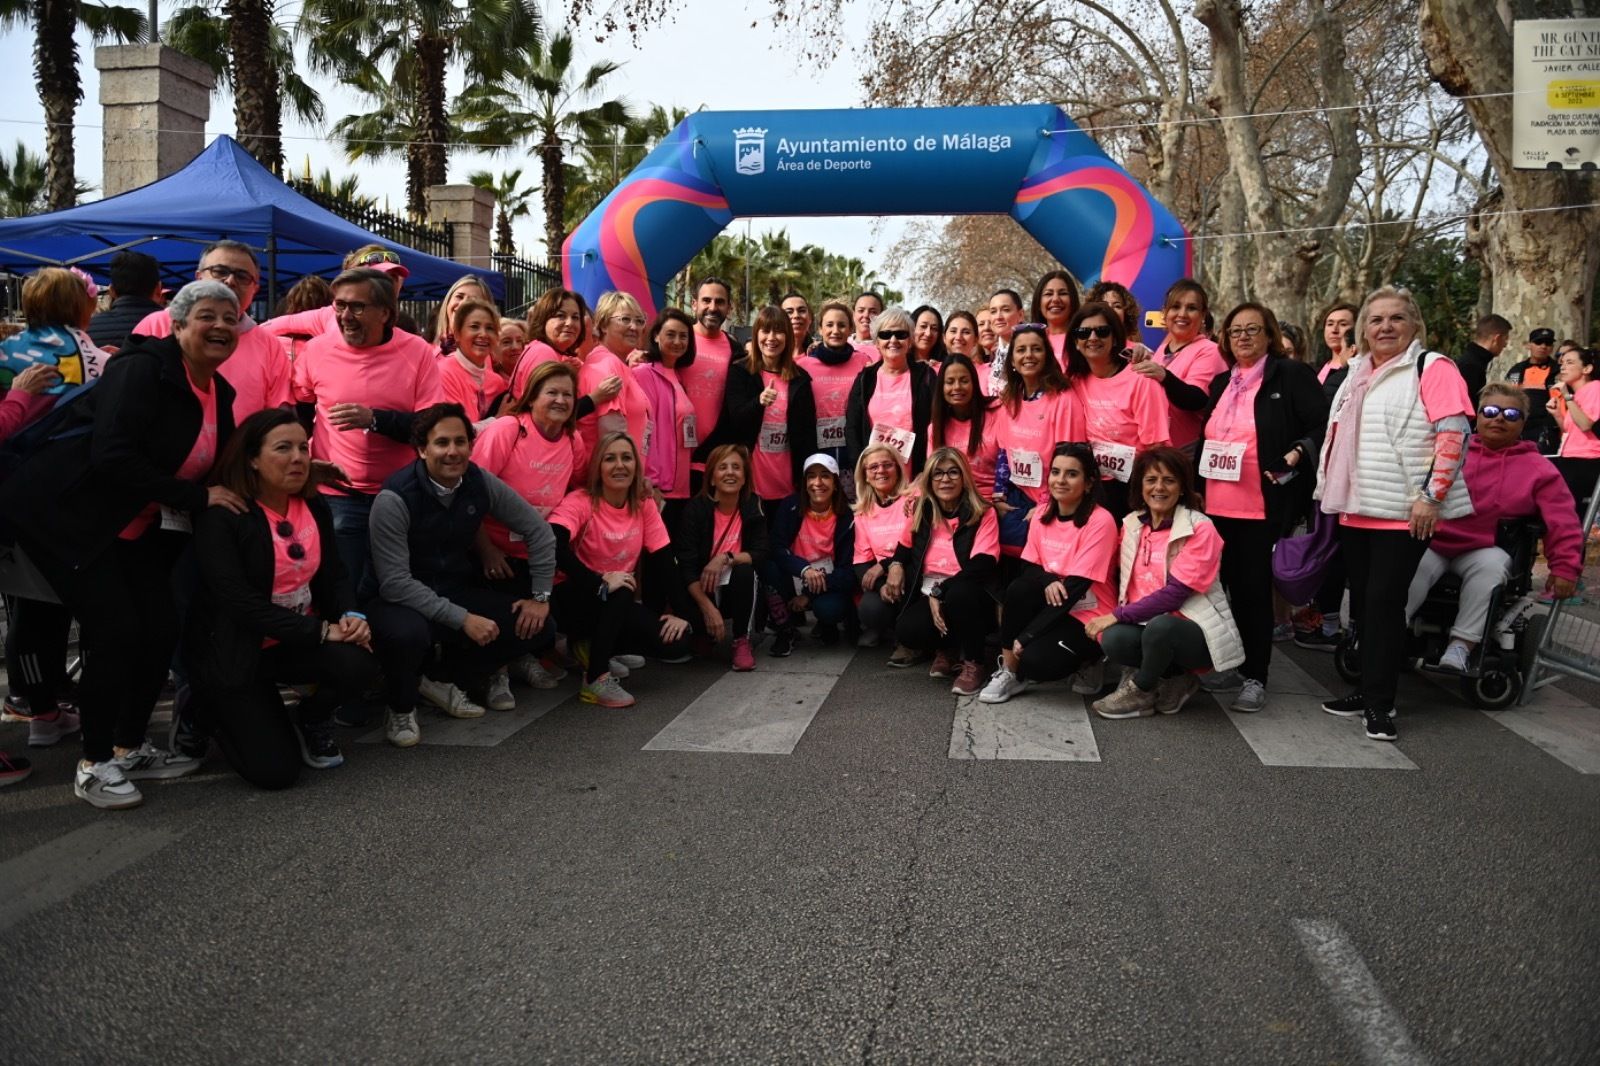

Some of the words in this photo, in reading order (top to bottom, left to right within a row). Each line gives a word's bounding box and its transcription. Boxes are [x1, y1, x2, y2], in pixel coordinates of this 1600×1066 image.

[1533, 45, 1554, 57] THE
[1560, 45, 1582, 56] CAT
[1544, 64, 1572, 72] JAVIER
[777, 136, 907, 157] Ayuntamiento
[914, 135, 936, 150] de
[943, 133, 1011, 153] Málaga
[777, 157, 804, 171] Área
[807, 160, 821, 170] de
[824, 159, 872, 172] Deporte
[1209, 454, 1237, 470] 3065
